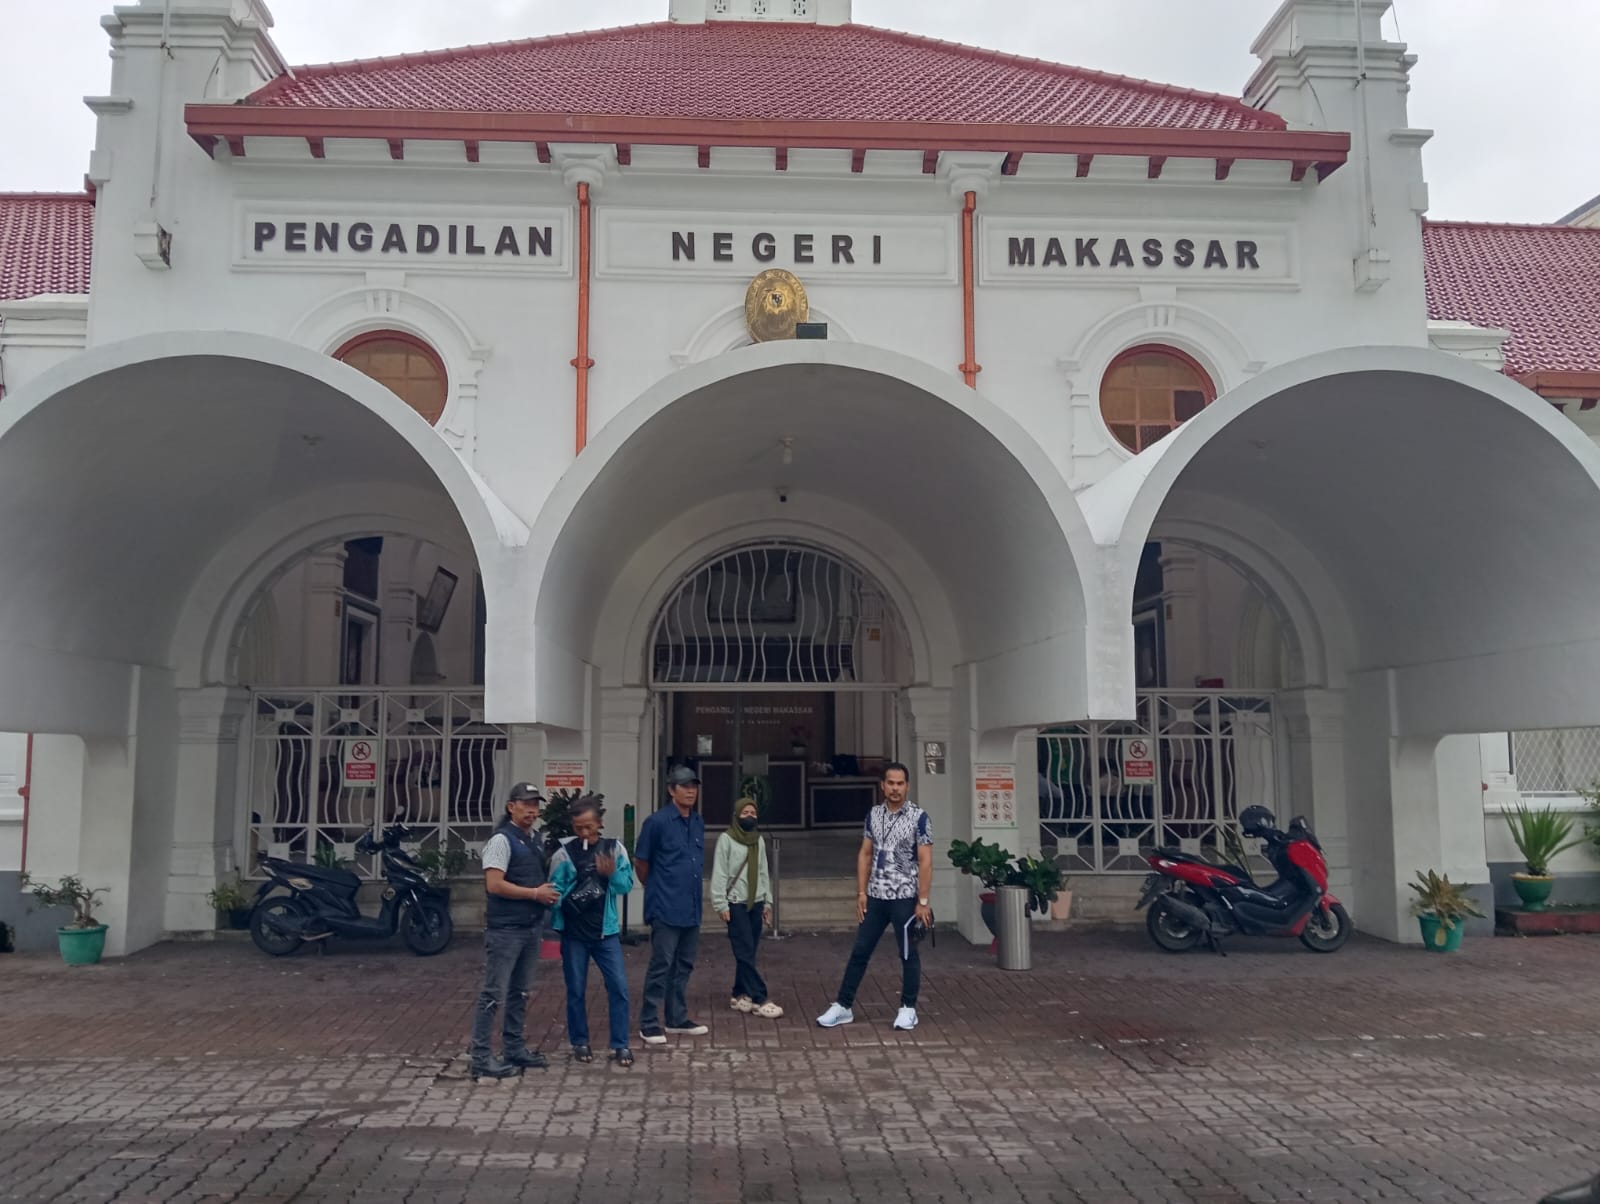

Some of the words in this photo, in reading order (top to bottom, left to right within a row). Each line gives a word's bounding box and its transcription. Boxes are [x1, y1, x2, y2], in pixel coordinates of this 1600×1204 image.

[254, 222, 552, 256] PENGADILAN
[672, 232, 881, 264] NEGERI
[1008, 237, 1259, 269] MAKASSAR
